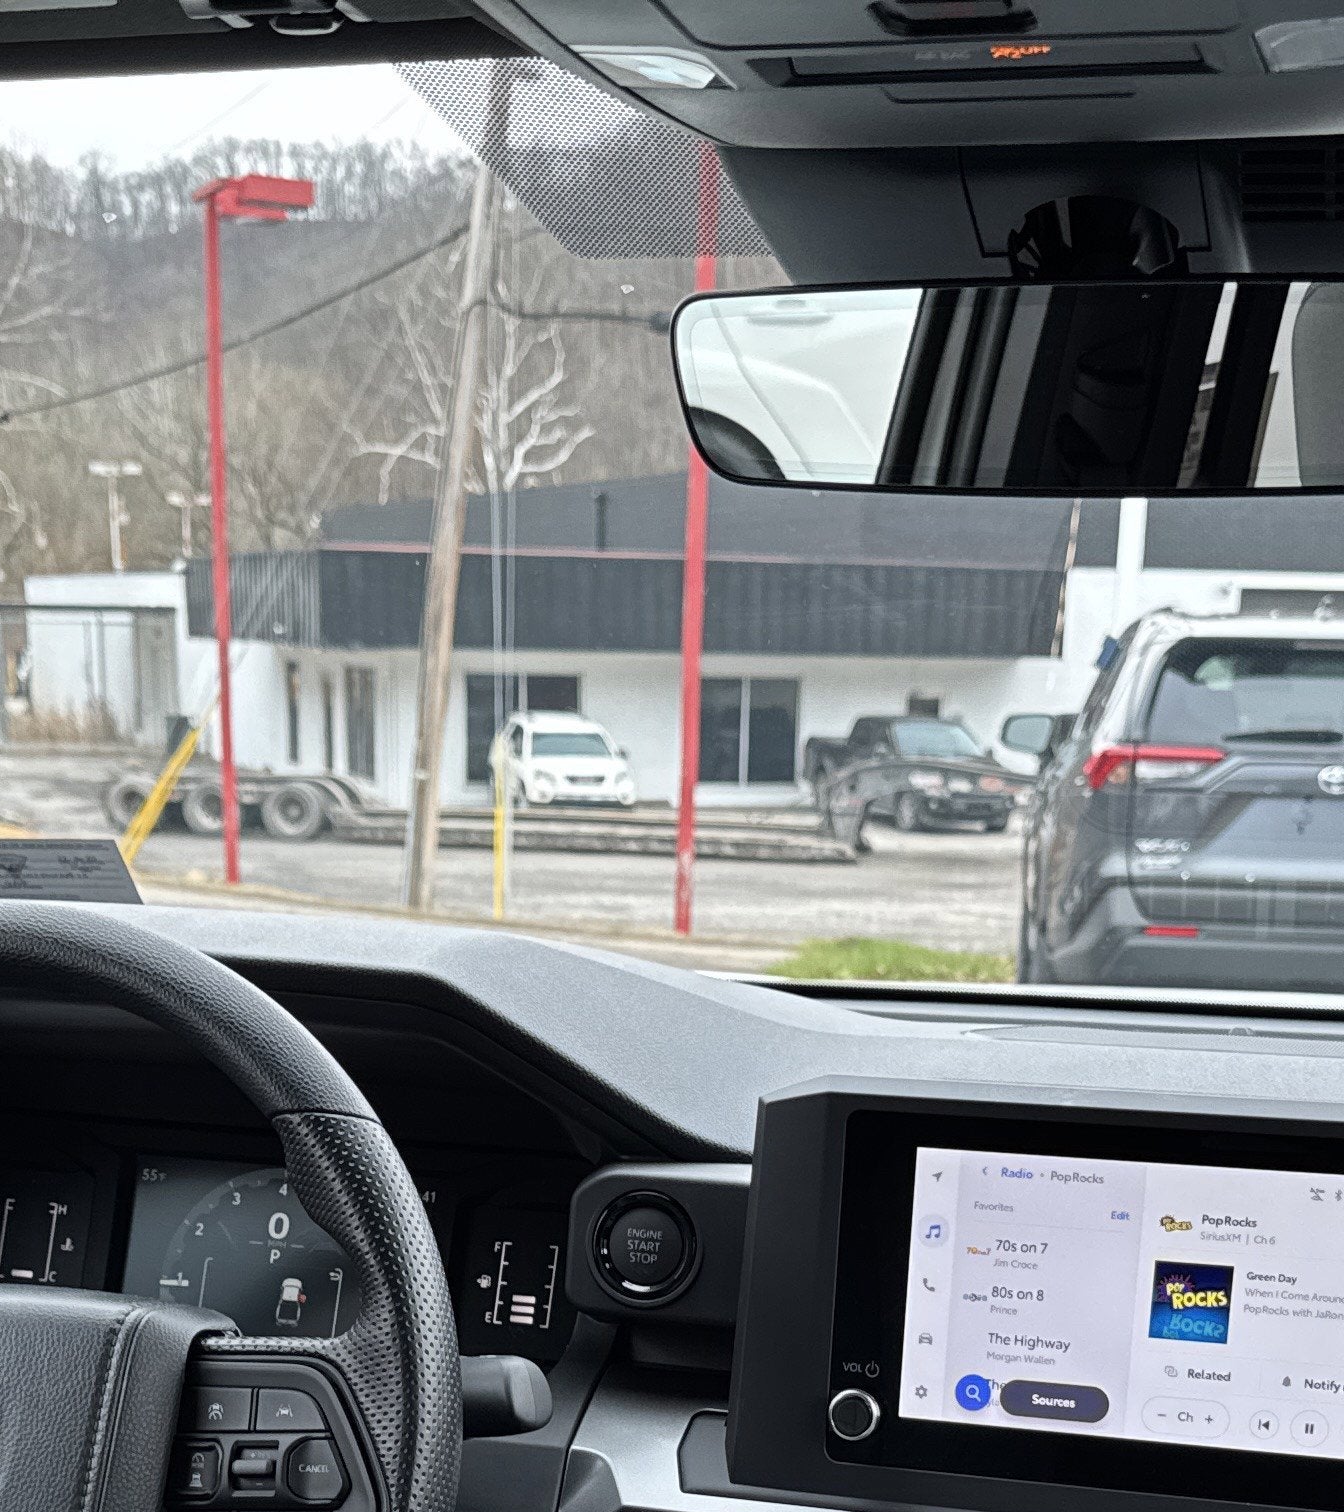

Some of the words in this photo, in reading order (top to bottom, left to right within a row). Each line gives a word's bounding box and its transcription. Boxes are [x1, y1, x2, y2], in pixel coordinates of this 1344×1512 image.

[1000, 1166, 1034, 1180] Radio
[278, 1183, 288, 1196] 4
[231, 1191, 242, 1206] 3
[973, 1200, 1014, 1213] Favorites
[1110, 1211, 1131, 1222] Edit
[194, 1222, 205, 1236] 2
[268, 1211, 290, 1240] 0
[626, 1228, 664, 1240] ENGINE
[1200, 1231, 1241, 1244] SiriusXM
[1253, 1234, 1268, 1246] Ch
[626, 1239, 662, 1252] START
[995, 1239, 1017, 1253] 70s
[1020, 1244, 1037, 1254] on
[1040, 1242, 1049, 1254] 7
[269, 1249, 281, 1264] P
[628, 1252, 658, 1265] STOP
[993, 1258, 1009, 1269] Jim
[1011, 1259, 1038, 1270] Croce
[1246, 1271, 1276, 1283] Green
[1278, 1273, 1298, 1286] Day
[991, 1286, 1014, 1300] 80s
[1016, 1290, 1033, 1301] on
[1036, 1289, 1045, 1302] 8
[1172, 1290, 1229, 1310] ROCKS
[1245, 1287, 1273, 1299] When
[1280, 1290, 1310, 1302] Come
[485, 1311, 493, 1323] E
[990, 1304, 1018, 1316] Prince
[1292, 1307, 1313, 1319] with
[988, 1332, 1011, 1347] The
[1014, 1334, 1071, 1353] Highway
[986, 1351, 1022, 1364] Morgan
[1024, 1355, 1056, 1366] Wallen
[842, 1361, 863, 1373] VOL
[1187, 1368, 1232, 1382] Related
[1304, 1379, 1341, 1394] Notify
[1031, 1393, 1076, 1409] Sources
[1177, 1411, 1194, 1423] Ch
[298, 1463, 329, 1474] CANCEL
